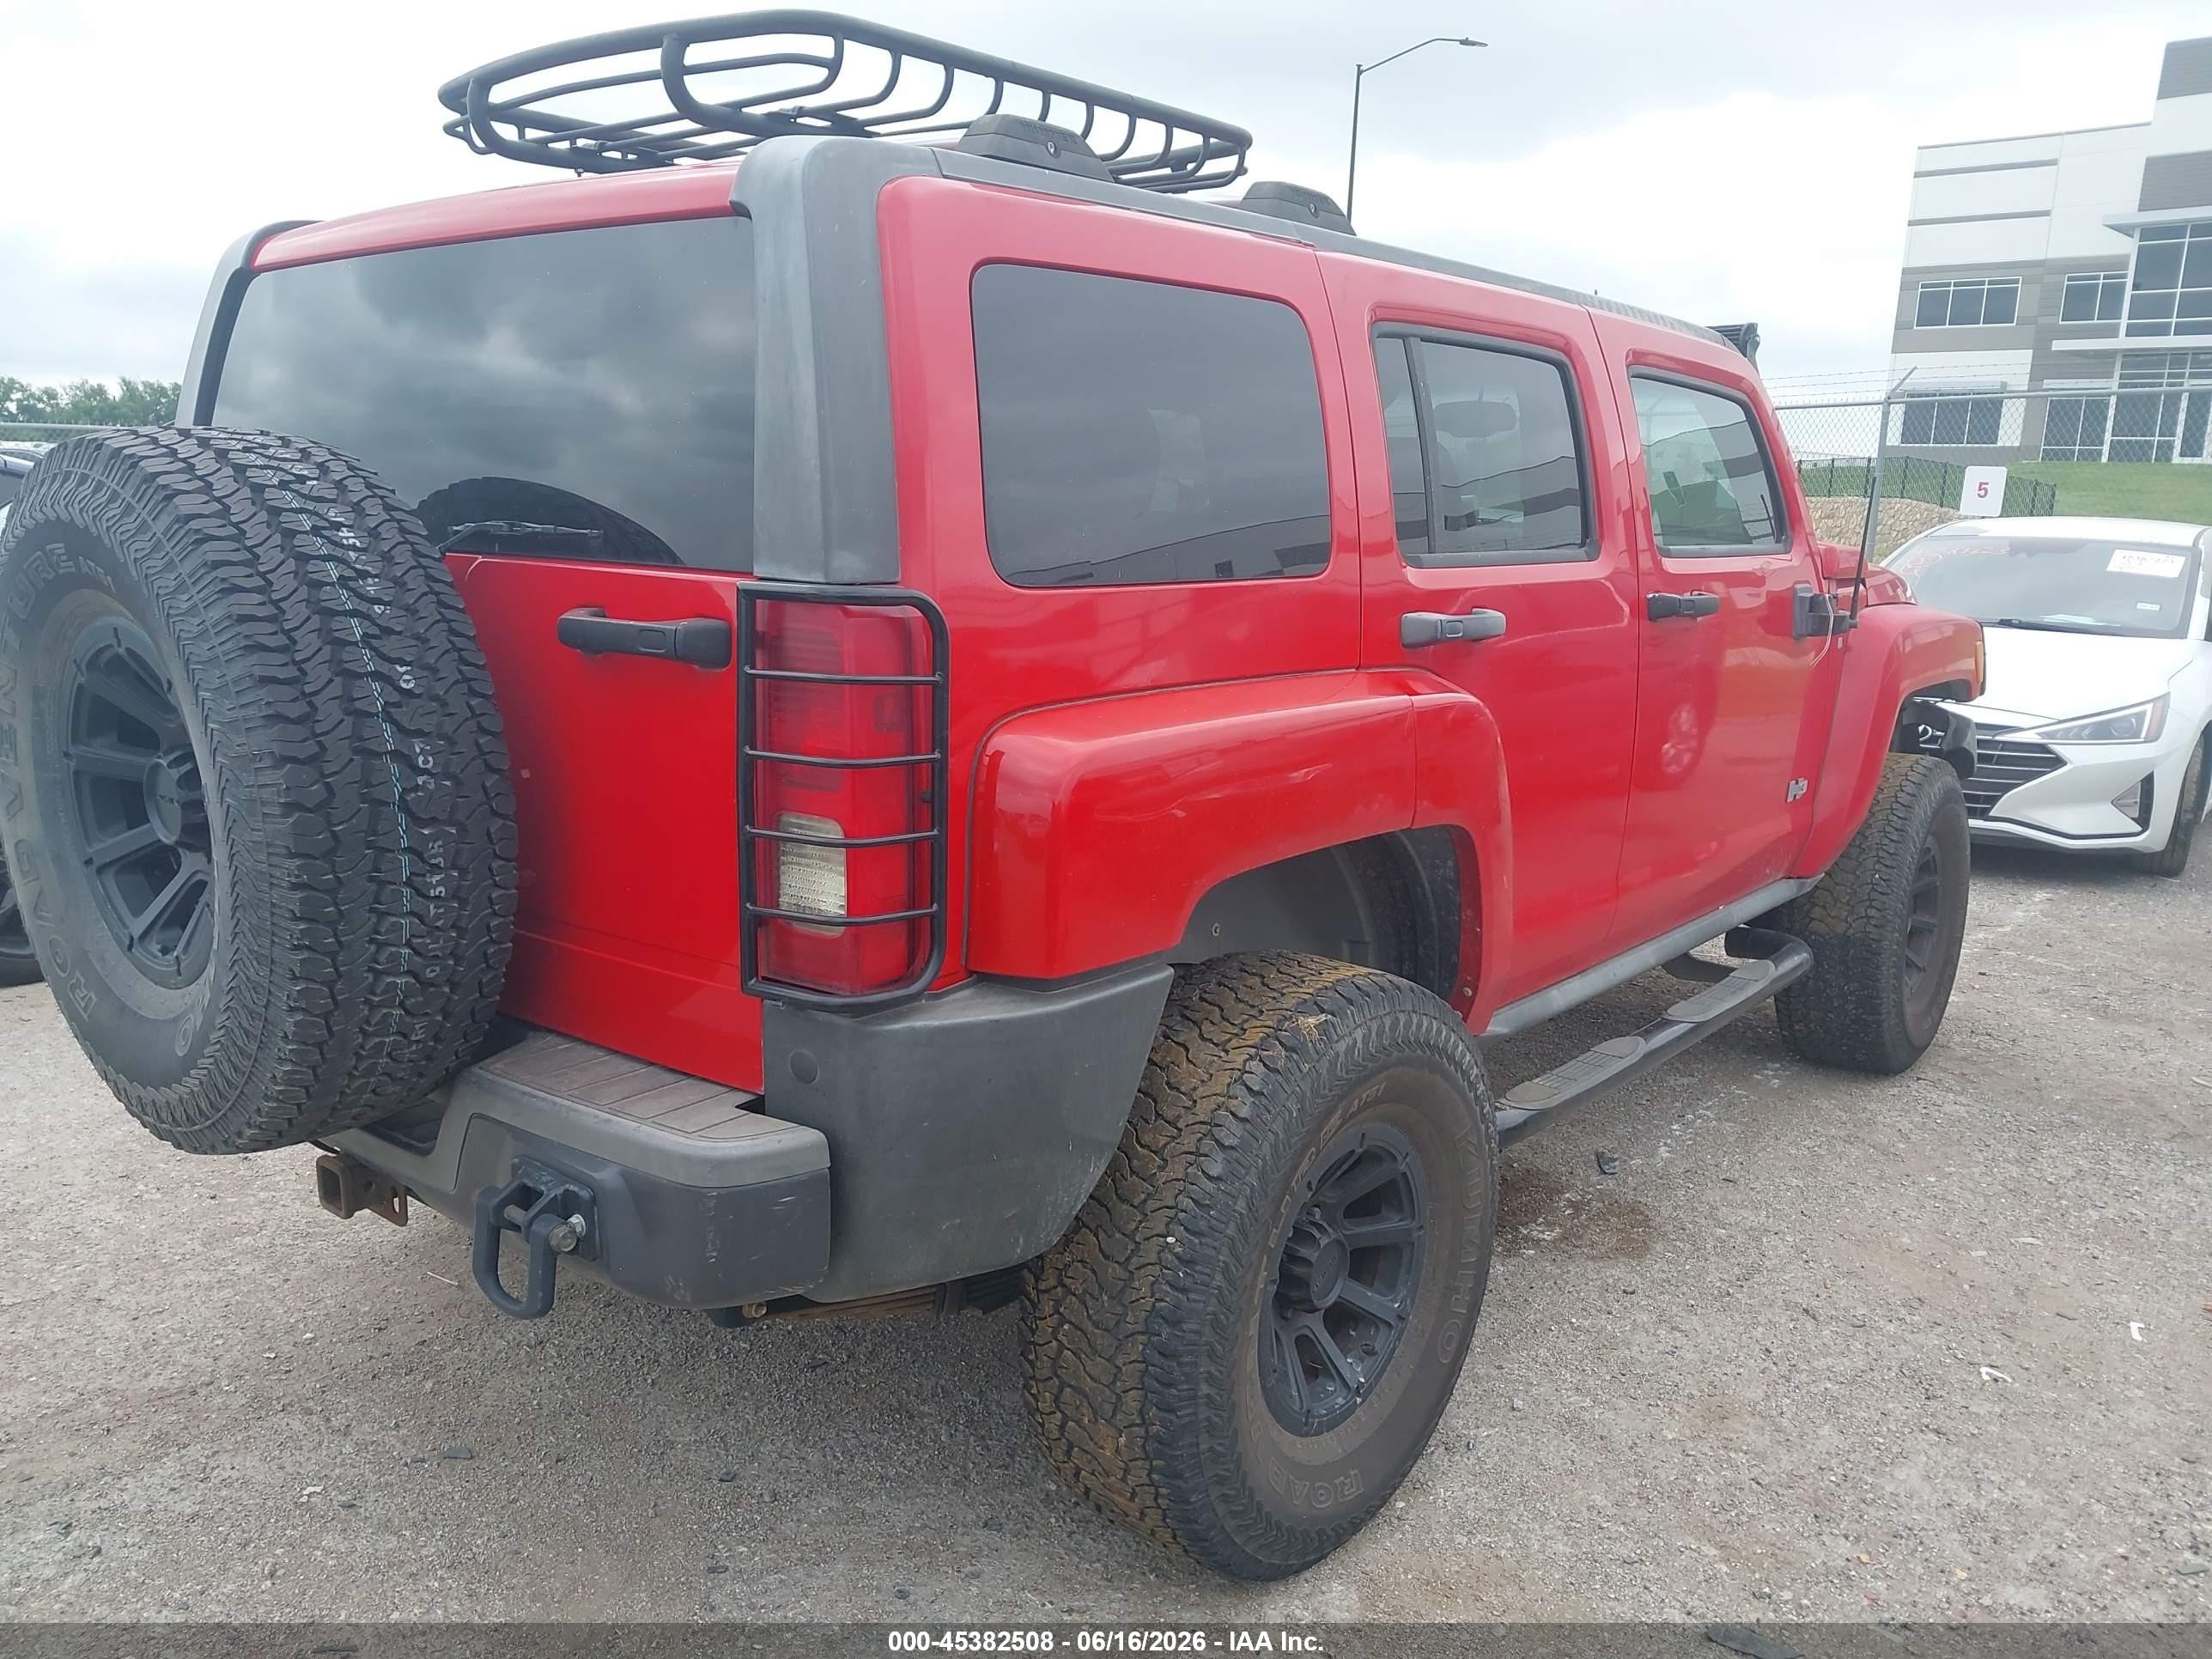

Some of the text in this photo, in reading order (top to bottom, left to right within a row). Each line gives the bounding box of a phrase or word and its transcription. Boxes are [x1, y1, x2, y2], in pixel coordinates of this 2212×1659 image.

[1977, 481, 1990, 499] 5
[1437, 1125, 1484, 1364] KUMHO
[1267, 1457, 1364, 1509] ROAD
